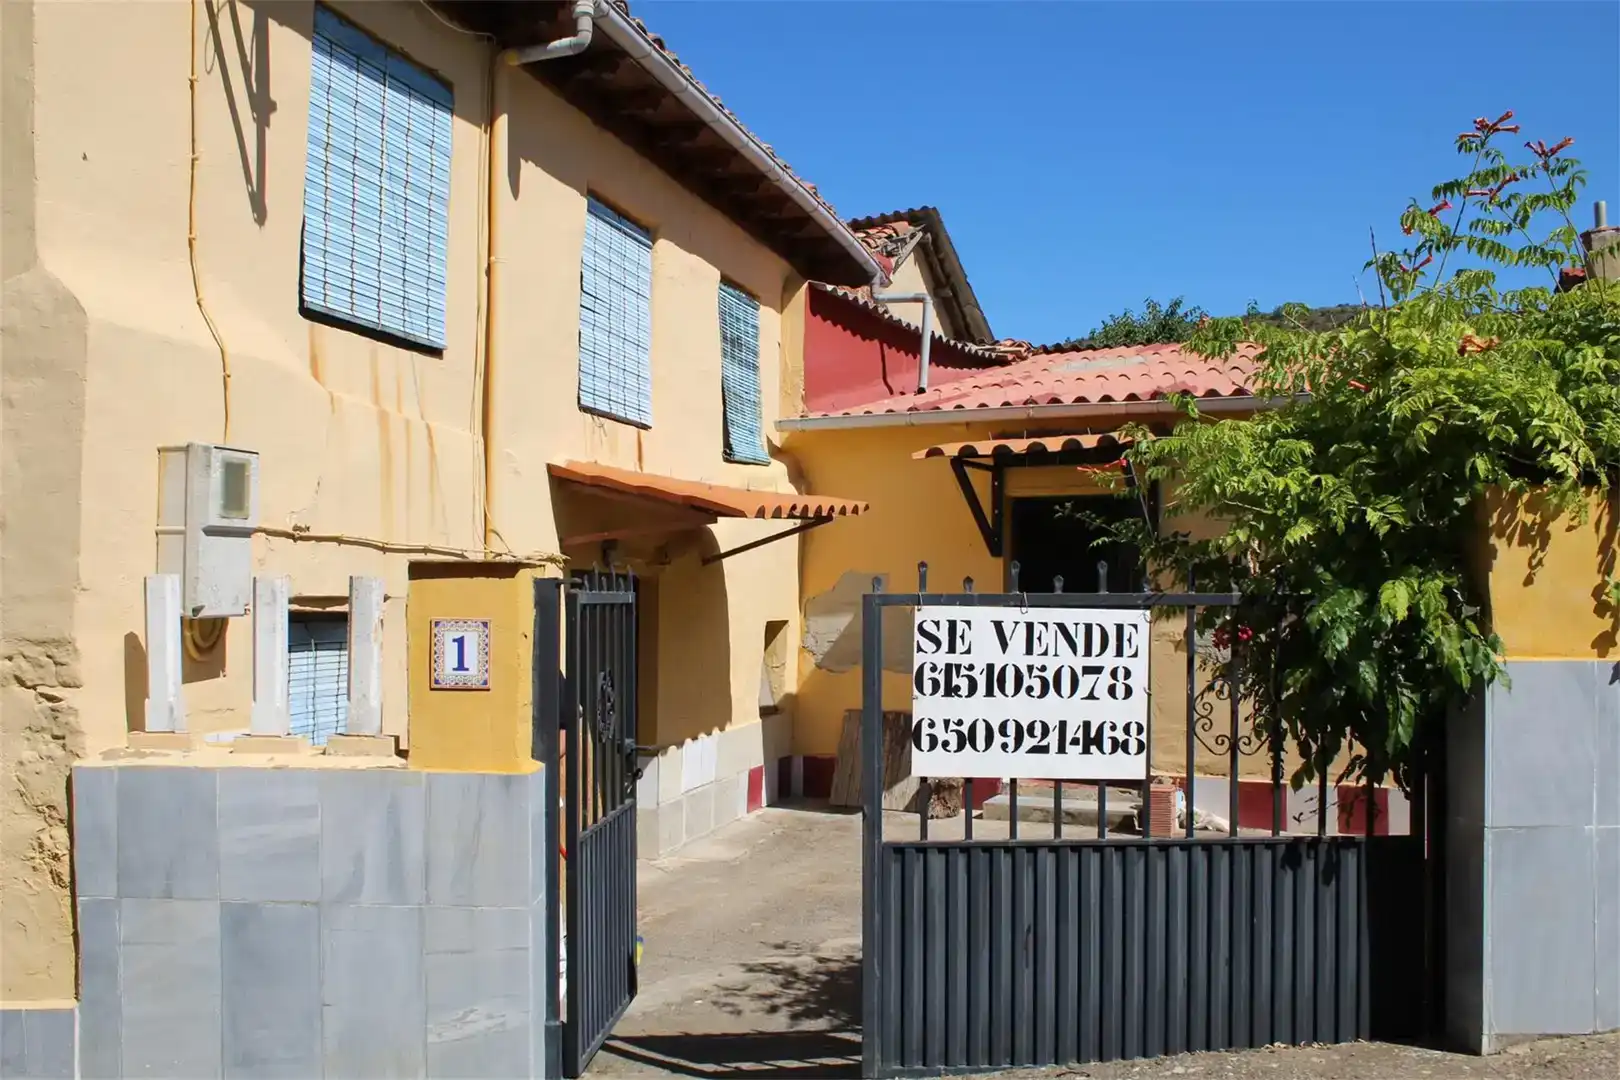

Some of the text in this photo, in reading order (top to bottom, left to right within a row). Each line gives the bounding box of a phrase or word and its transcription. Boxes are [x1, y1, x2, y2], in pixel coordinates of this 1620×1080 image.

[452, 635, 470, 671] 1
[916, 619, 1139, 658] SE VENDE
[914, 661, 1133, 701] 615105078
[912, 717, 1146, 756] 650921468
